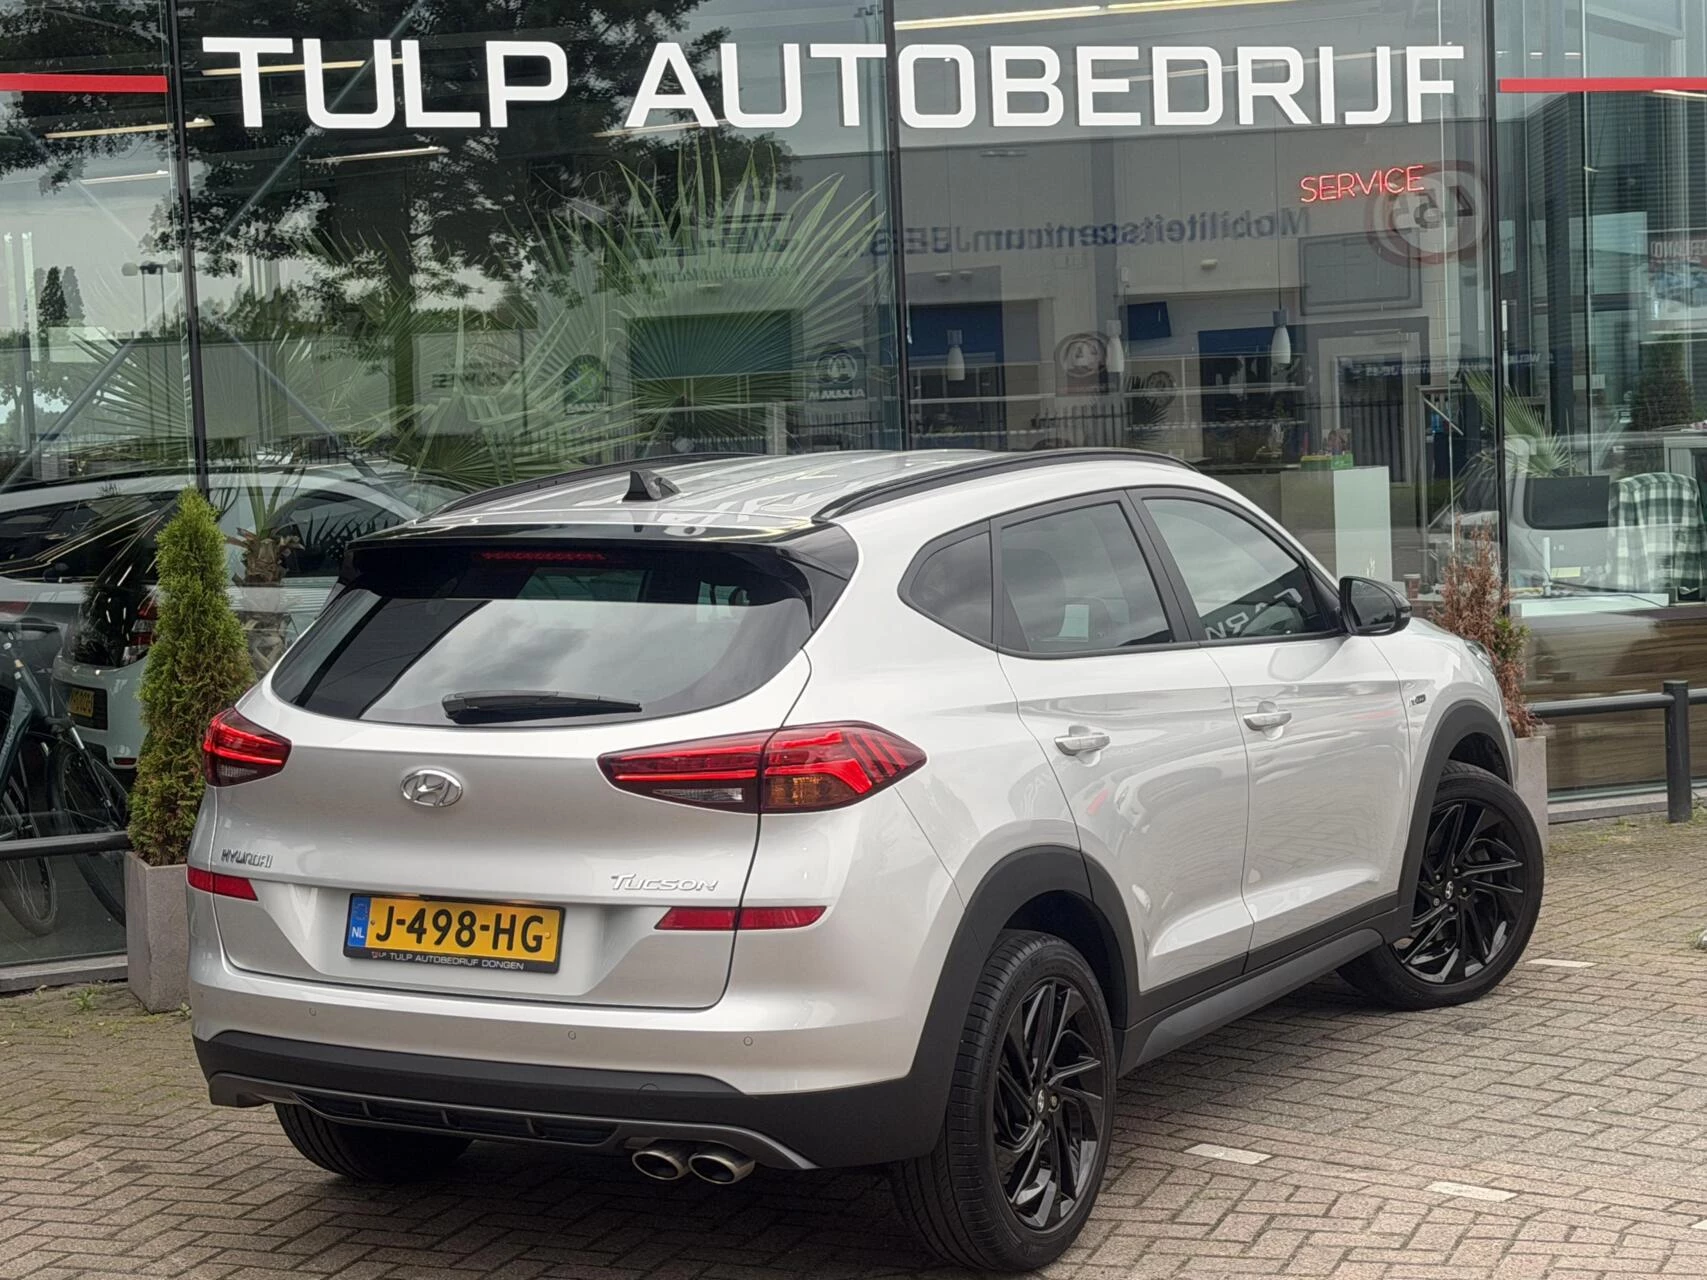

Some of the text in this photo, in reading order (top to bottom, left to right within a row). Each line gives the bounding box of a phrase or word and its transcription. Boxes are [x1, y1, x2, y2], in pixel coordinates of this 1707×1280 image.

[202, 37, 1464, 129] TULP AUTOBEDRIJF
[1299, 164, 1425, 204] SERVICE
[351, 926, 365, 939] NL
[375, 905, 544, 953] J-498-HG
[389, 953, 413, 962] TULP
[415, 954, 479, 968] AUTOBEDRIJF
[482, 959, 525, 971] DONGEN
